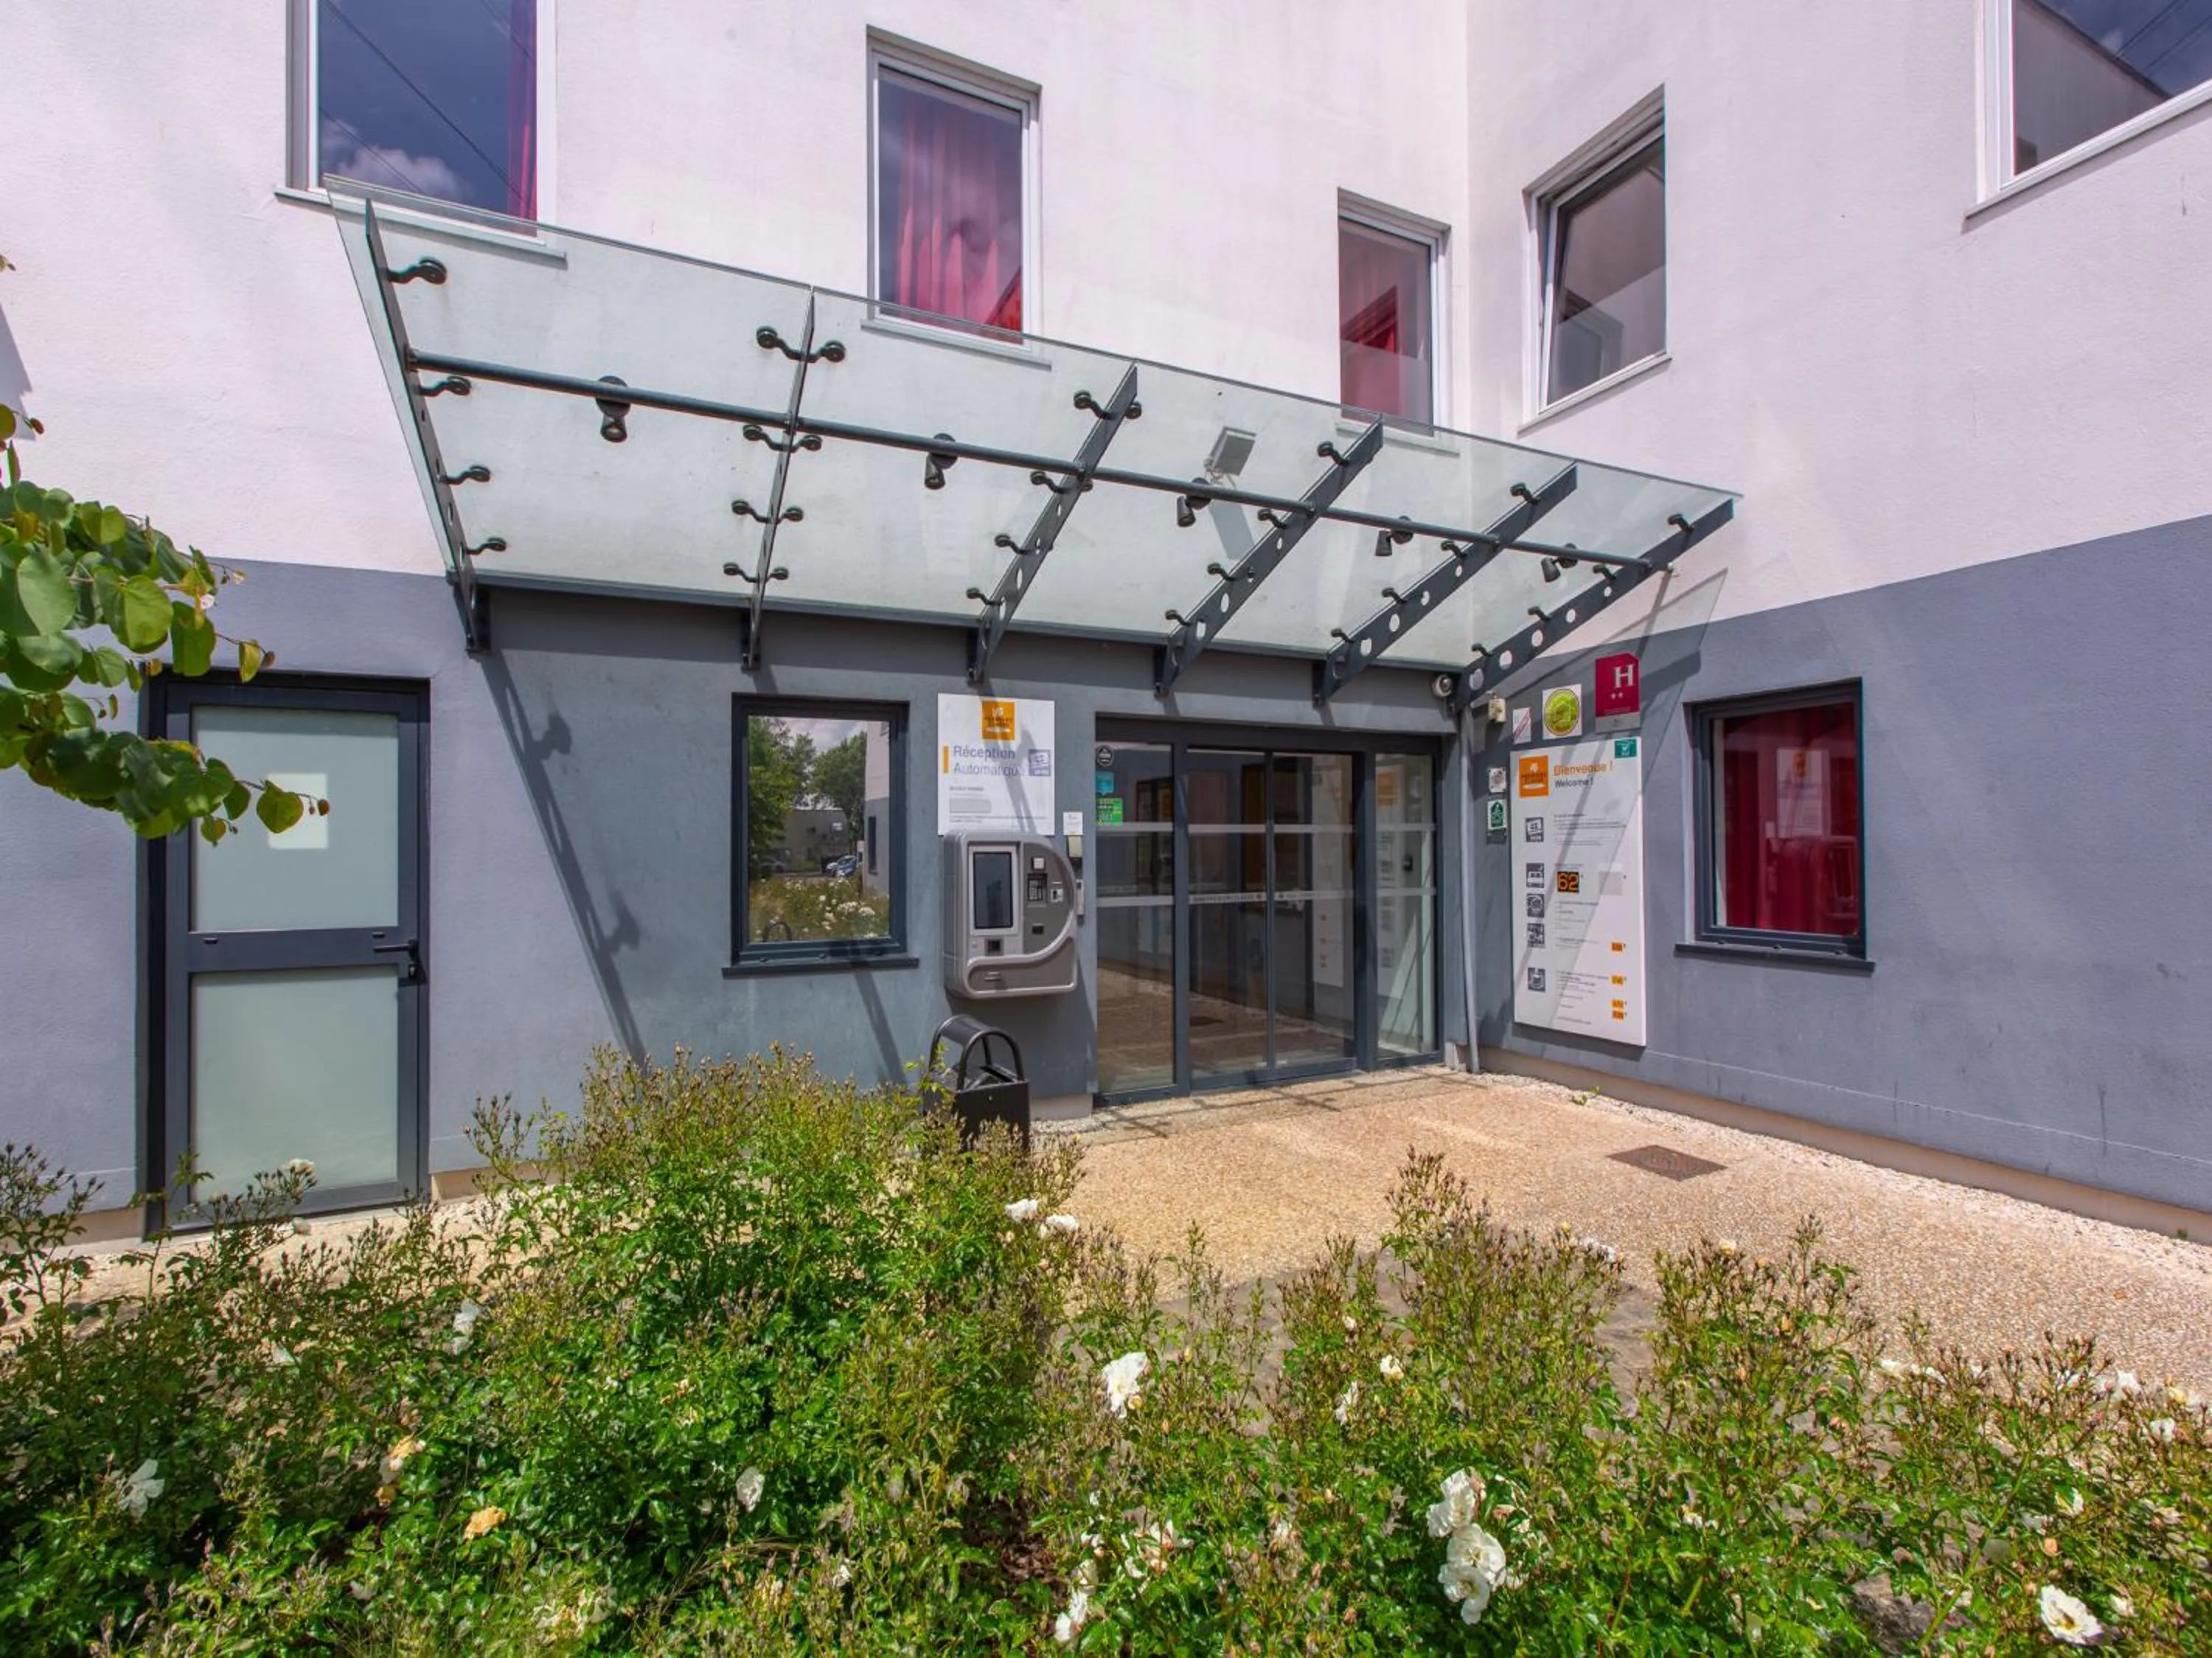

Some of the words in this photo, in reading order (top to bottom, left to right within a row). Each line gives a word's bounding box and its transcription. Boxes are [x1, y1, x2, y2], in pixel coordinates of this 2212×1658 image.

[1615, 664, 1633, 688] H
[953, 745, 1016, 762] Réception
[1554, 763, 1607, 777] Bienvenue
[1558, 873, 1579, 891] 62
